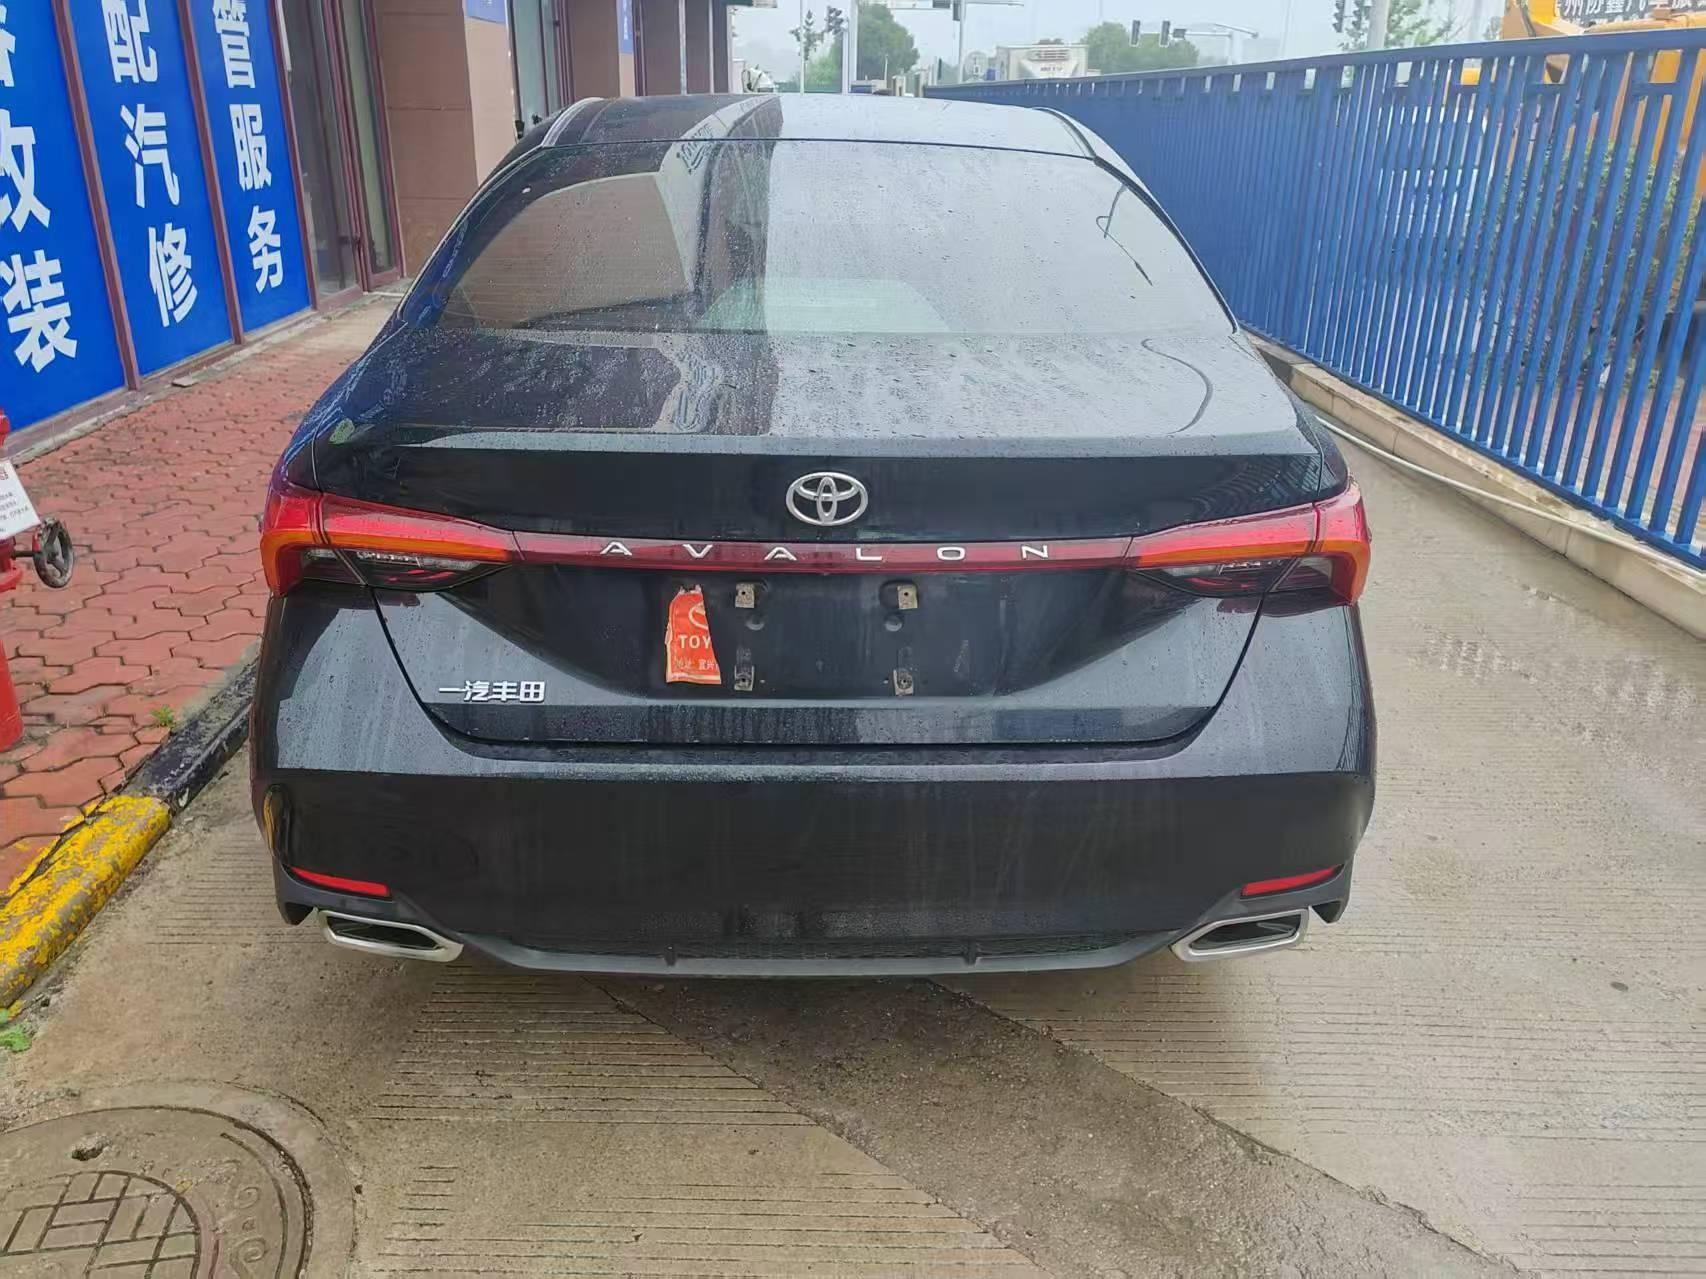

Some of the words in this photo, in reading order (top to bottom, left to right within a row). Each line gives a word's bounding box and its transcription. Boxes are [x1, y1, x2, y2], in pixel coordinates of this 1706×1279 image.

[101, 0, 197, 327] 配汽修
[213, 0, 284, 293] 管服务
[600, 541, 1049, 561] AVALON
[438, 680, 546, 703] 一汽丰田
